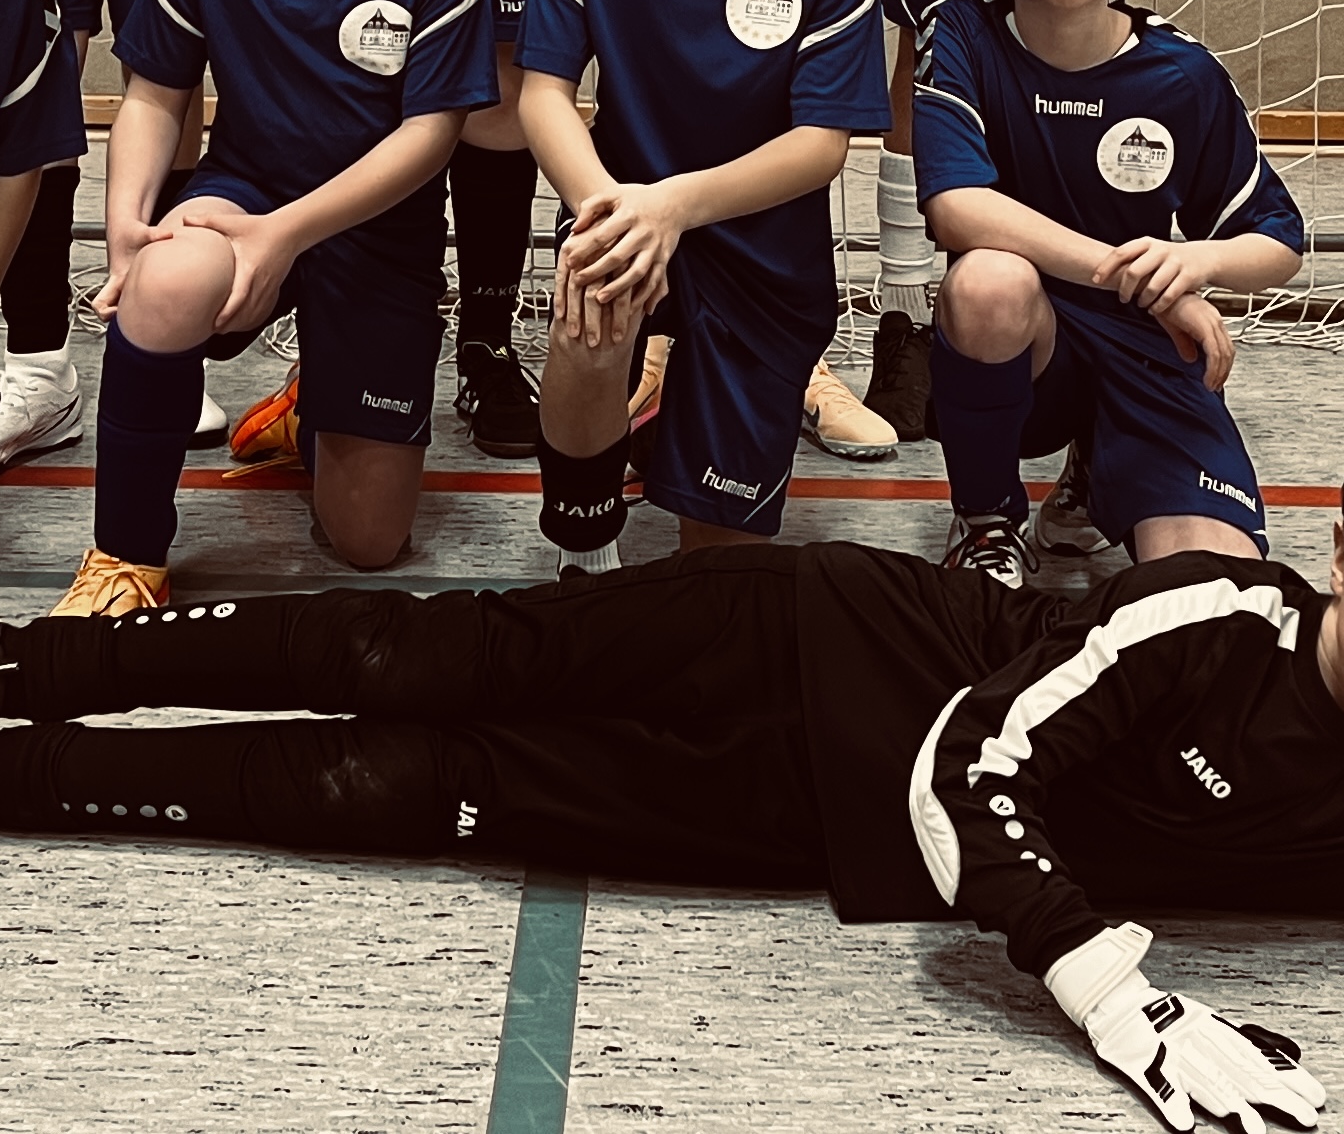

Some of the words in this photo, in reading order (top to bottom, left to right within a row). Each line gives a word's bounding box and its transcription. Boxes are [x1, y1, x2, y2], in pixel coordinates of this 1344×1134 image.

[1035, 93, 1104, 118] hummel
[472, 284, 518, 297] JAKO
[361, 390, 414, 415] hummel
[702, 466, 762, 501] hummel
[1199, 470, 1257, 513] hummel
[554, 497, 615, 518] JAKO
[1180, 746, 1232, 799] JAKO
